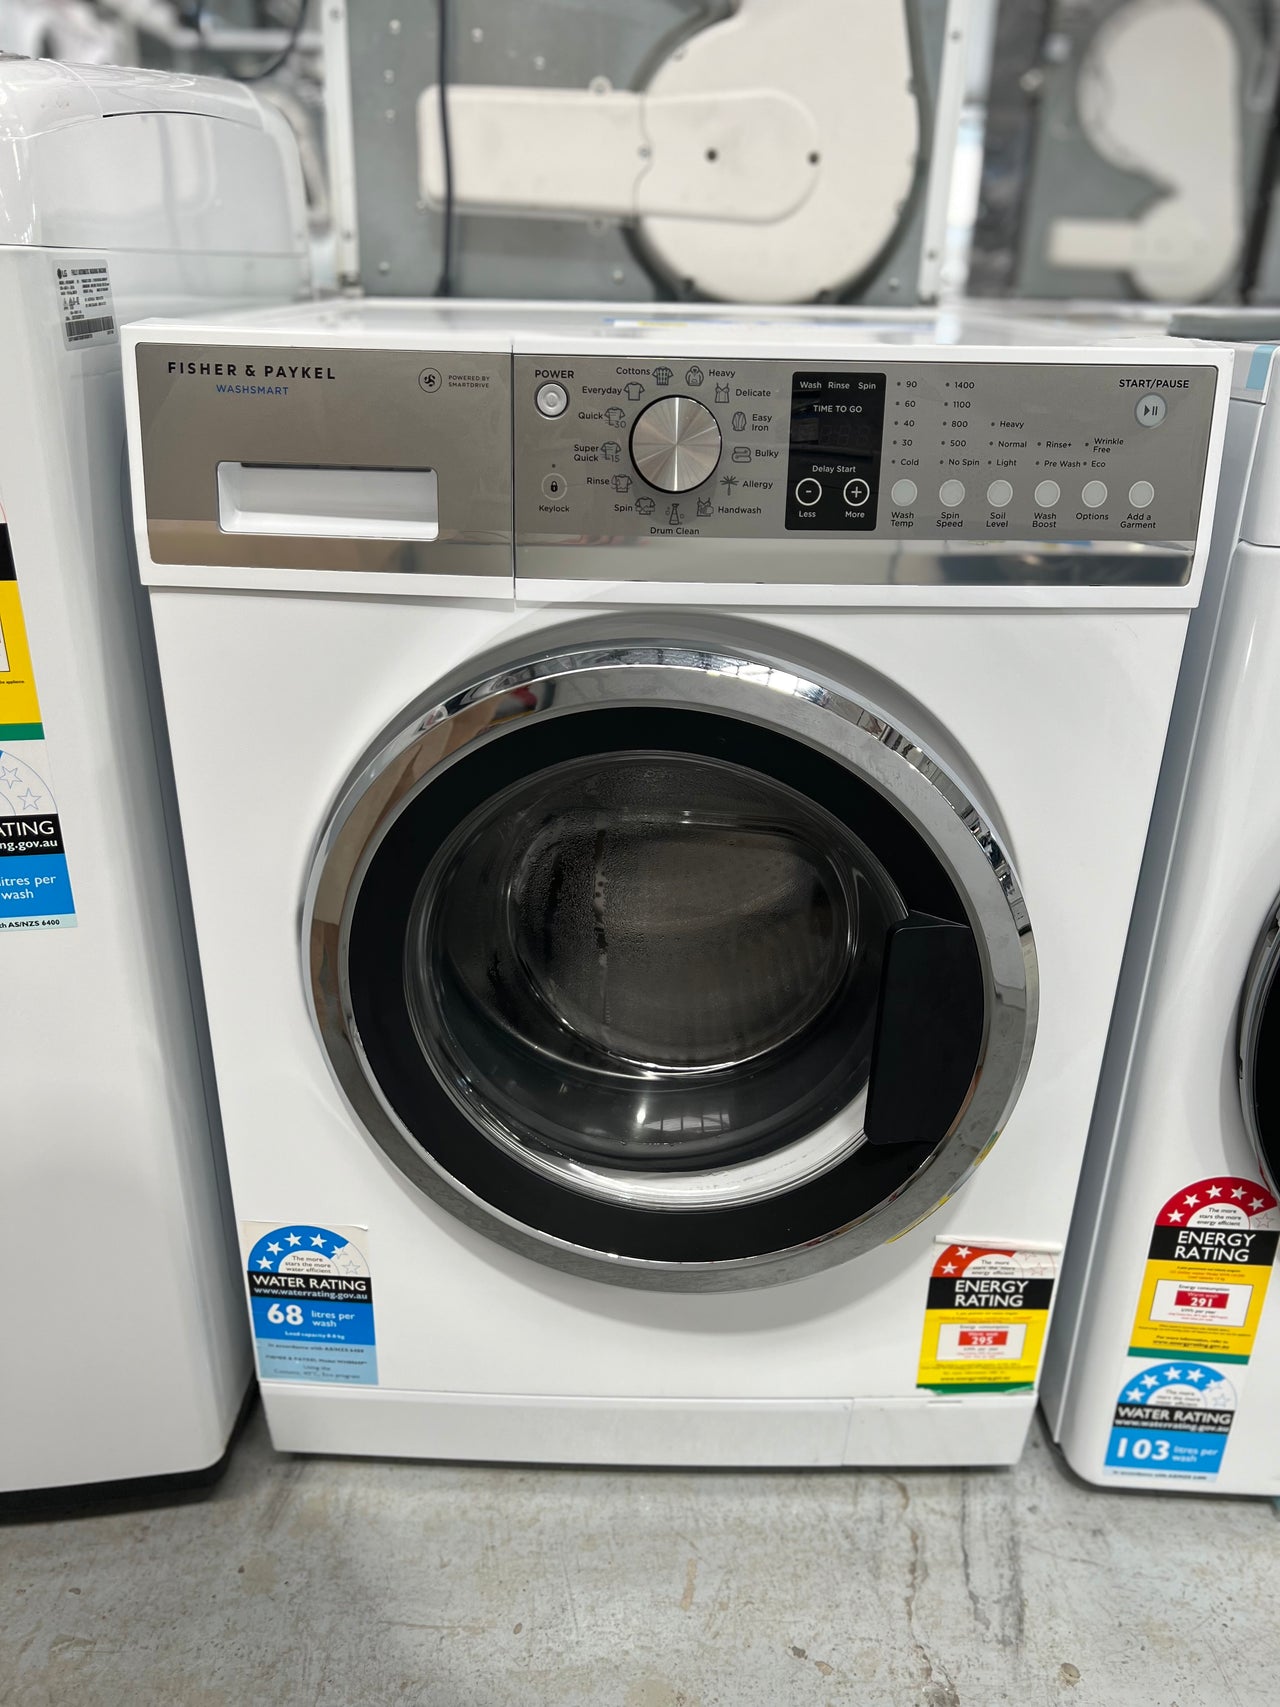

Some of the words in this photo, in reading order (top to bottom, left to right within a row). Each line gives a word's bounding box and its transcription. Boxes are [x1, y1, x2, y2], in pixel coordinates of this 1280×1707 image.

[167, 361, 238, 376] FISHER
[245, 364, 256, 377] &
[264, 365, 336, 380] PAYKEL
[534, 369, 575, 379] POWER
[616, 366, 651, 376] Cottons
[708, 369, 736, 379] Heavy
[448, 381, 490, 389] SMARTDRIVE
[800, 381, 822, 389] Wash
[828, 382, 850, 390] Rinse
[858, 382, 876, 391] Spin
[1119, 379, 1190, 389] START/PAUSE
[216, 384, 289, 396] WASHSMART
[582, 386, 623, 396] Everyday
[735, 388, 771, 397] Delicate
[813, 405, 833, 413] TIME
[835, 405, 847, 413] TO
[849, 405, 862, 413] GO
[904, 400, 916, 408] 60
[578, 411, 603, 421] Quick
[752, 413, 772, 423] Easy
[752, 423, 769, 432] Iron
[999, 421, 1024, 429] Heavy
[573, 444, 599, 454] Super
[1046, 441, 1072, 449] Rinse+
[573, 454, 599, 463] Quick
[755, 449, 779, 459] Bulky
[962, 459, 980, 467] Spin
[996, 459, 1017, 467] Light
[812, 465, 835, 474] Delay
[586, 477, 610, 485] Rinse
[742, 480, 774, 490] Allergy
[538, 504, 570, 513] Keylock
[614, 504, 633, 513] Spin
[718, 505, 762, 514] Handwash
[1034, 512, 1057, 520] Wash
[1075, 513, 1109, 521] Options
[891, 520, 914, 528] Temp
[936, 520, 963, 528] Speed
[1120, 521, 1156, 529] Garment
[650, 527, 674, 535] Drum
[675, 527, 700, 535] Clean
[0, 877, 30, 887] itres
[34, 876, 56, 888] per
[1, 889, 34, 900] wash
[1177, 1230, 1256, 1247] ENERGY
[1174, 1245, 1250, 1262] RATING
[253, 1275, 306, 1288] WATER
[309, 1278, 366, 1291] RATING
[955, 1280, 1029, 1293] ENERGY
[254, 1287, 368, 1300] www.waterrating.gov.au
[954, 1294, 1024, 1307] RATING
[1190, 1297, 1213, 1307] 291
[267, 1303, 304, 1326] 68
[311, 1310, 336, 1319] litres
[338, 1313, 355, 1321] per
[312, 1319, 336, 1327] wash
[971, 1336, 994, 1345] 295
[1117, 1406, 1170, 1420] WATER
[1173, 1410, 1231, 1425] RATING
[1117, 1437, 1170, 1461] 103
[1174, 1445, 1199, 1455] litres
[1201, 1448, 1219, 1457] per
[1172, 1455, 1197, 1463] wash
